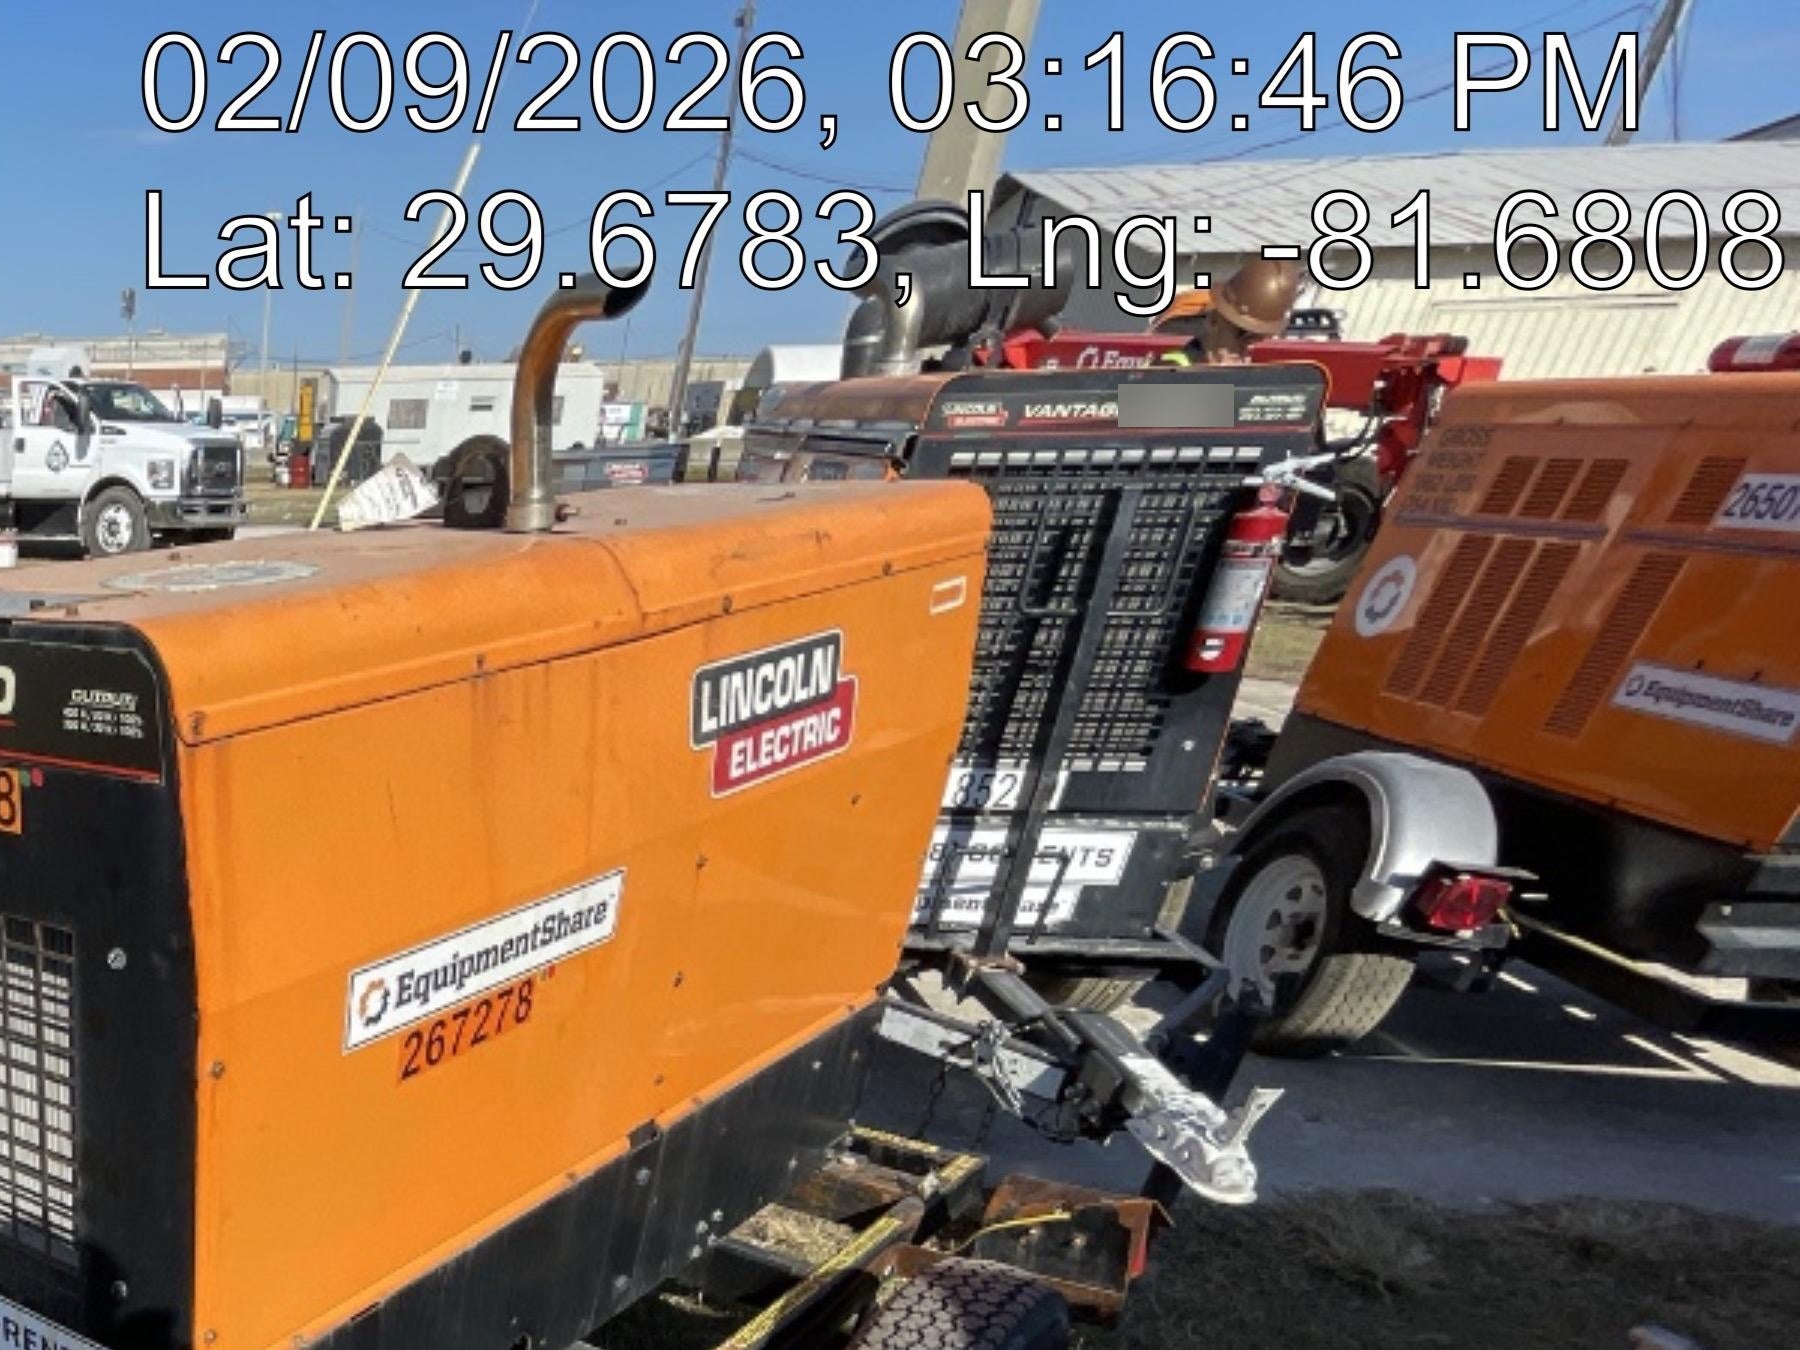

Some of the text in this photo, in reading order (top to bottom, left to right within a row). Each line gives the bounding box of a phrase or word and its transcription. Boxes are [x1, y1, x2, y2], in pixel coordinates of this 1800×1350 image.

[1024, 401, 1118, 418] VANTAG
[700, 644, 835, 733] LINCOLN
[1643, 679, 1796, 727] EquipmentShare
[727, 707, 842, 780] ELECTRIC
[393, 898, 609, 1010] EquipmentShare
[400, 978, 536, 1081] 267278
